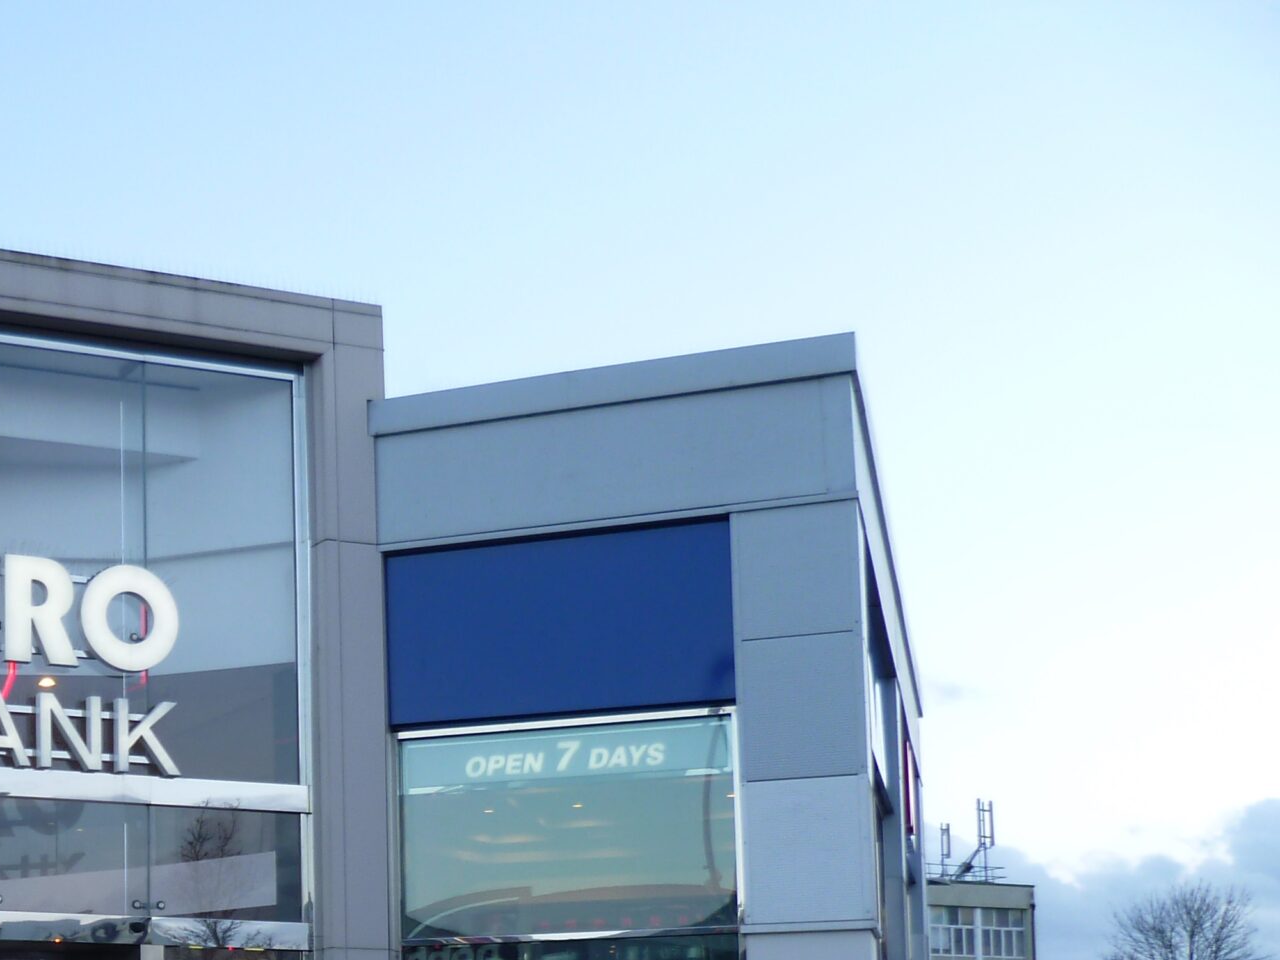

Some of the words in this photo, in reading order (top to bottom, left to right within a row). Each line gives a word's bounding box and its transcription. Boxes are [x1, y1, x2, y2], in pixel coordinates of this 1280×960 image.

[465, 752, 544, 778] OPEN
[556, 740, 581, 771] 7
[588, 743, 666, 770] DAYS
